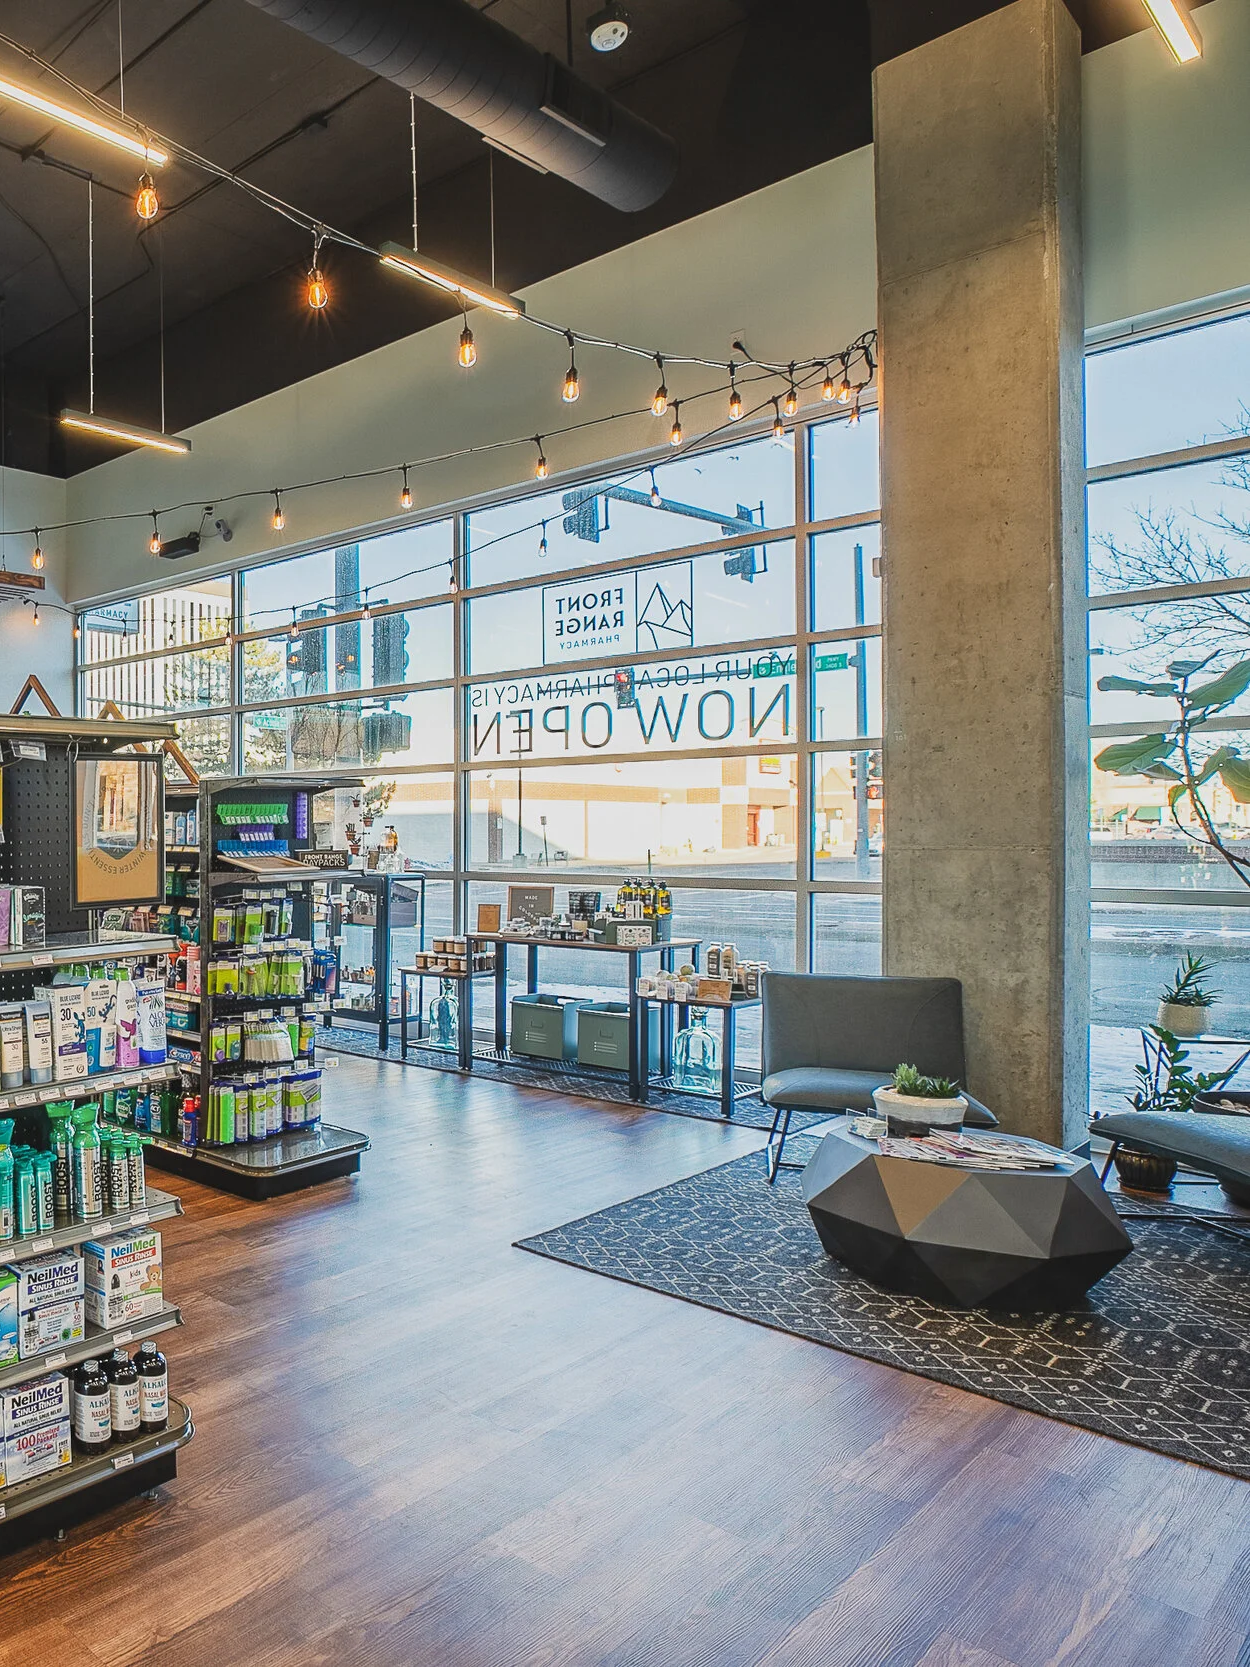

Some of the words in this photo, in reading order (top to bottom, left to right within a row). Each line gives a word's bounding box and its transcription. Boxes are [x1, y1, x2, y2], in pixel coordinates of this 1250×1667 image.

[120, 851, 146, 875] WINTER
[302, 858, 346, 867] DAYPACKS
[94, 1160, 102, 1202] BOOST
[44, 1180, 53, 1219] BOOST
[111, 1236, 156, 1258] NeilMed
[114, 1256, 134, 1267] SINUS
[134, 1250, 153, 1261] RINSE
[27, 1262, 78, 1285] NeilMed
[31, 1281, 53, 1293] SINUS
[54, 1276, 75, 1288] RINSE
[37, 1292, 54, 1301] NATURAL
[11, 1382, 64, 1409] NeilMed
[15, 1405, 38, 1418] SINUS
[38, 1396, 59, 1410] RINSE
[21, 1415, 38, 1427] NATURAL
[38, 1412, 50, 1421] SINUS
[36, 1425, 60, 1440] Premixed
[36, 1432, 58, 1444] Packets
[16, 1434, 36, 1452] 100
[58, 1439, 68, 1447] FREE
